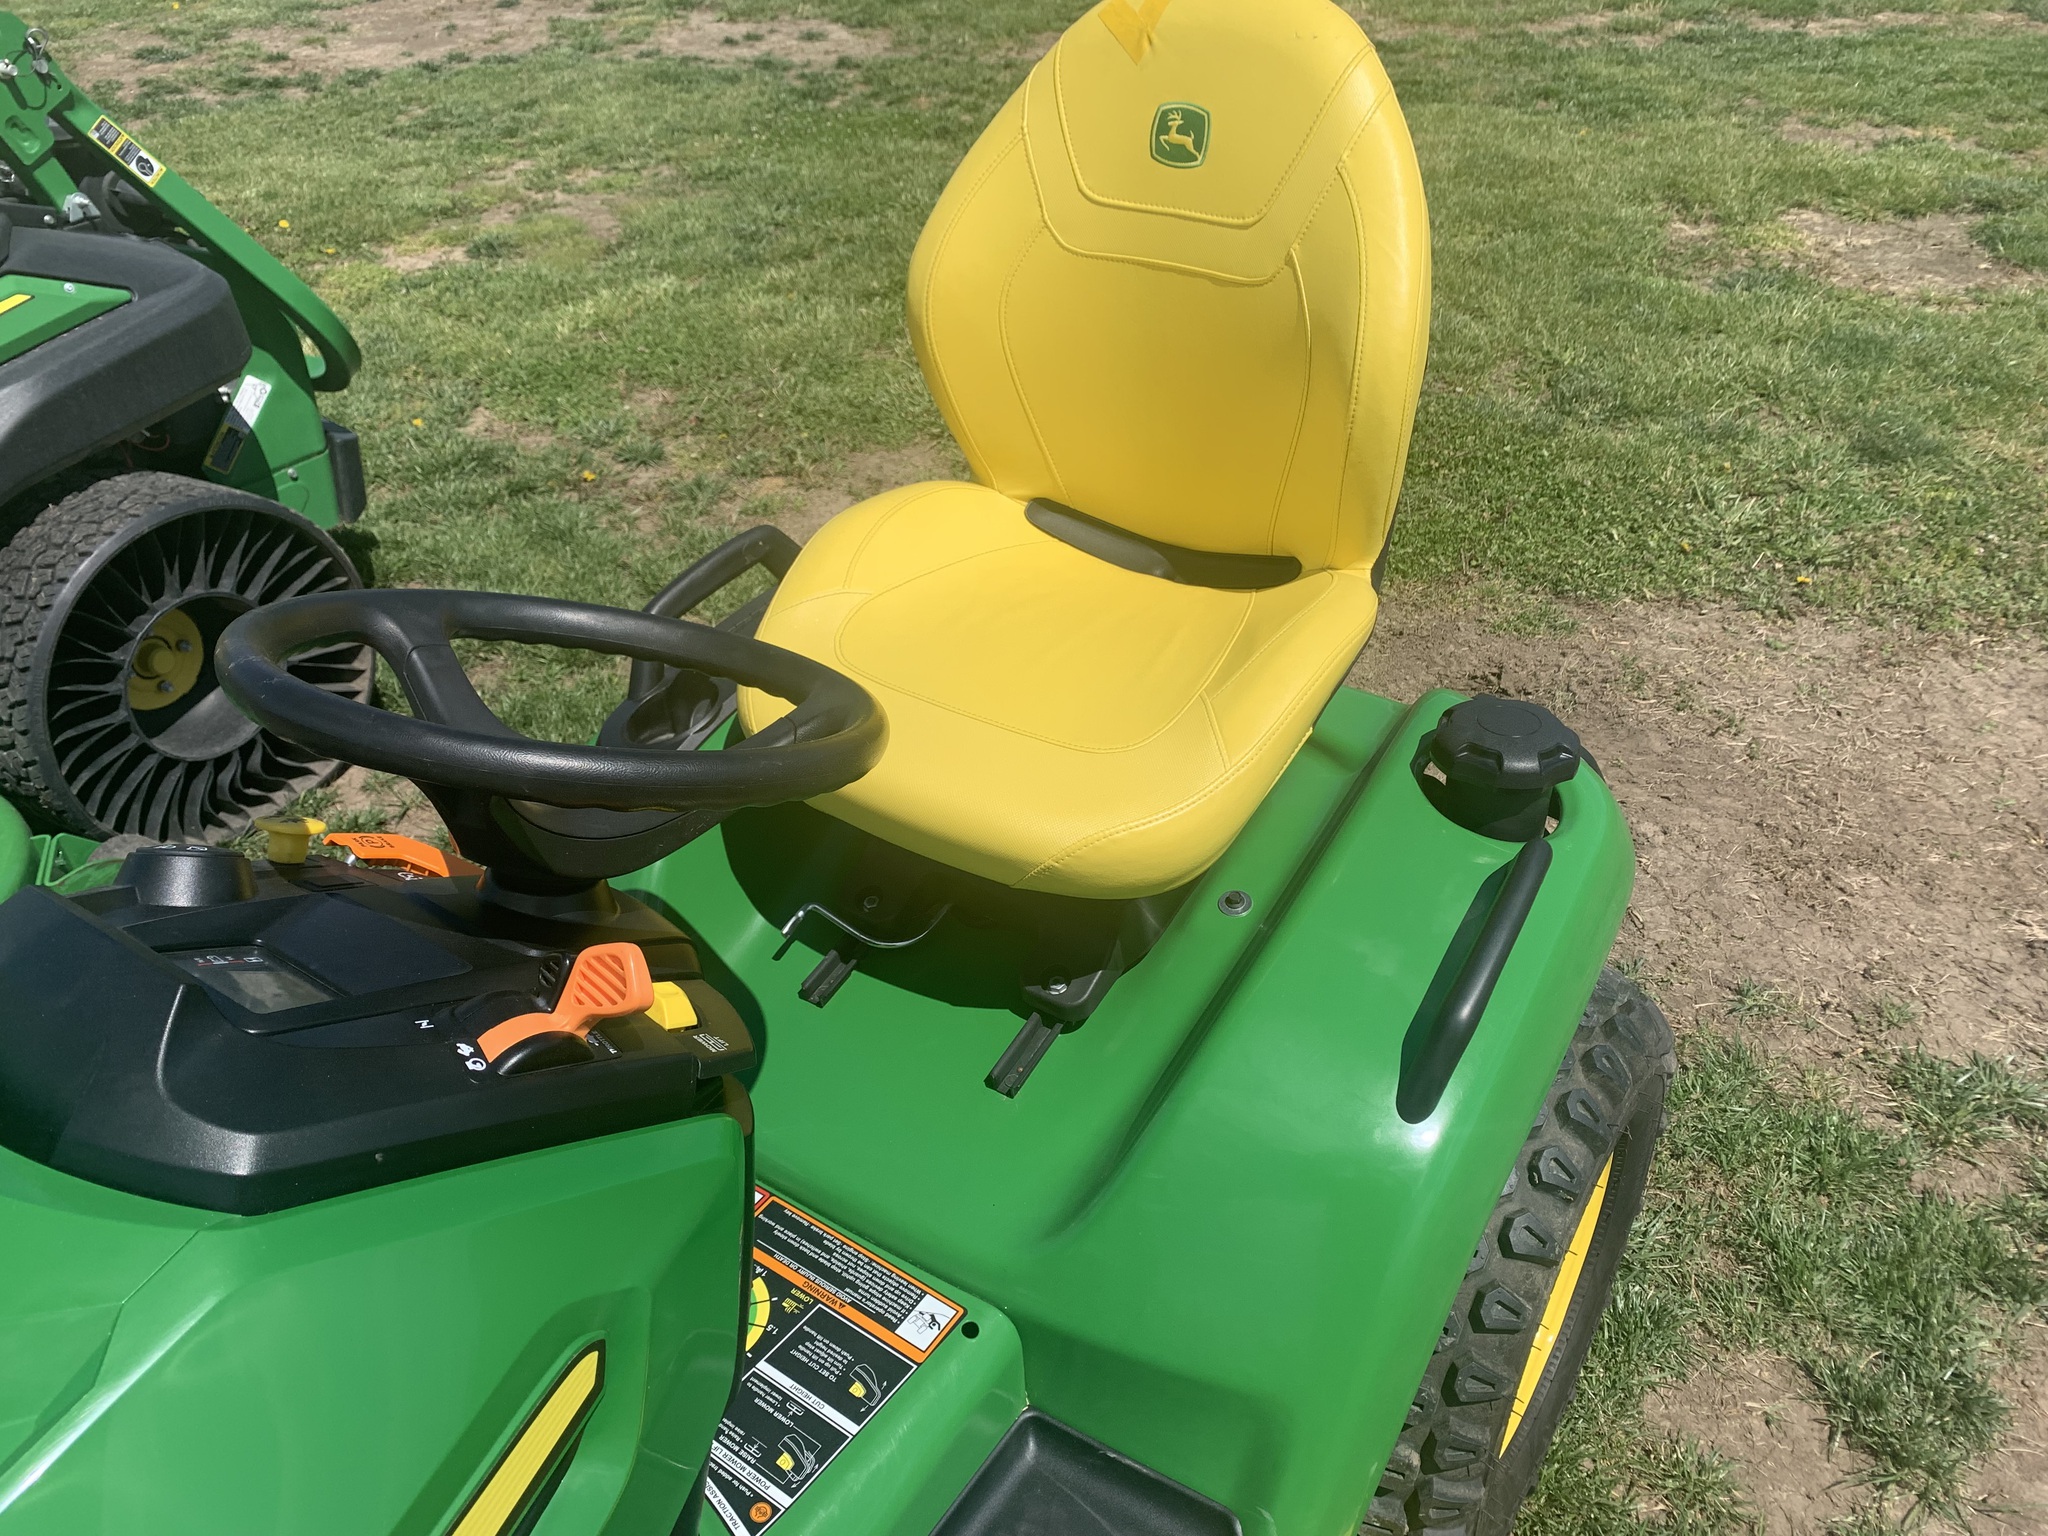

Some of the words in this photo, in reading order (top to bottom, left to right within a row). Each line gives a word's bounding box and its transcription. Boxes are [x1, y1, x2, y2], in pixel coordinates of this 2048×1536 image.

[693, 1035, 717, 1052] MOWER
[713, 1036, 729, 1046] LIFT
[783, 1208, 792, 1216] key
[758, 1214, 776, 1226] working
[773, 1229, 788, 1240] slowly
[783, 1229, 797, 1239] place
[810, 1225, 824, 1235] brake
[823, 1232, 834, 1240] park
[787, 1238, 800, 1247] down
[823, 1240, 836, 1250] blade
[799, 1245, 811, 1255] back
[842, 1244, 858, 1256] engine
[773, 1253, 791, 1265] DEATH
[818, 1257, 831, 1267] blade
[832, 1252, 848, 1263] across
[841, 1251, 858, 1263] thrown
[797, 1268, 816, 1281] INJURY
[830, 1265, 842, 1273] stop
[872, 1269, 882, 1277] that
[855, 1279, 870, 1290] going
[865, 1279, 884, 1292] devices
[872, 1276, 886, 1286] down
[882, 1275, 899, 1287] objects
[891, 1273, 908, 1287] leaving
[814, 1278, 837, 1294] SERIOUS
[907, 1284, 921, 1295] When
[790, 1288, 814, 1305] LOWER
[802, 1281, 838, 1307] WARNING
[835, 1292, 852, 1303] AVOID
[844, 1287, 862, 1300] manual
[858, 1288, 871, 1299] turns
[868, 1288, 882, 1298] stops
[883, 1289, 898, 1300] safety
[898, 1285, 918, 1300] Remove
[870, 1296, 888, 1309] sudden
[881, 1296, 902, 1310] machine
[897, 1299, 910, 1309] Keep
[901, 1294, 914, 1304] Drive
[861, 1298, 886, 1314] operator's
[884, 1312, 898, 1323] Read
[887, 1307, 902, 1318] Avoid
[766, 1324, 778, 1334] 1.5
[803, 1325, 818, 1337] handle
[798, 1344, 813, 1357] handle
[805, 1342, 815, 1350] stop
[814, 1340, 828, 1351] height
[829, 1342, 842, 1352] down
[790, 1349, 810, 1363] HEIGHT
[814, 1348, 828, 1358] adjust
[826, 1349, 843, 1361] desired
[841, 1350, 853, 1360] Push
[808, 1361, 820, 1370] CUT
[829, 1366, 840, 1375] Pull
[833, 1360, 843, 1370] Turn
[818, 1368, 830, 1377] SET
[828, 1374, 837, 1382] TO
[750, 1376, 772, 1393] implement
[751, 1385, 766, 1397] handle
[770, 1391, 783, 1401] lower
[789, 1384, 813, 1401] HEIGHT
[754, 1397, 775, 1414] MOWER
[765, 1395, 778, 1406] Lower
[811, 1399, 825, 1410] CUT
[773, 1411, 794, 1428] LOWER
[729, 1431, 741, 1442] Raise
[734, 1426, 746, 1436] raise
[719, 1434, 740, 1452] MOWER
[738, 1449, 757, 1464] RAISE
[722, 1452, 747, 1473] MOWER
[717, 1468, 733, 1481] added
[732, 1479, 740, 1487] for
[746, 1470, 771, 1491] POWER
[739, 1484, 751, 1496] Push
[715, 1498, 741, 1531] TRACTION
